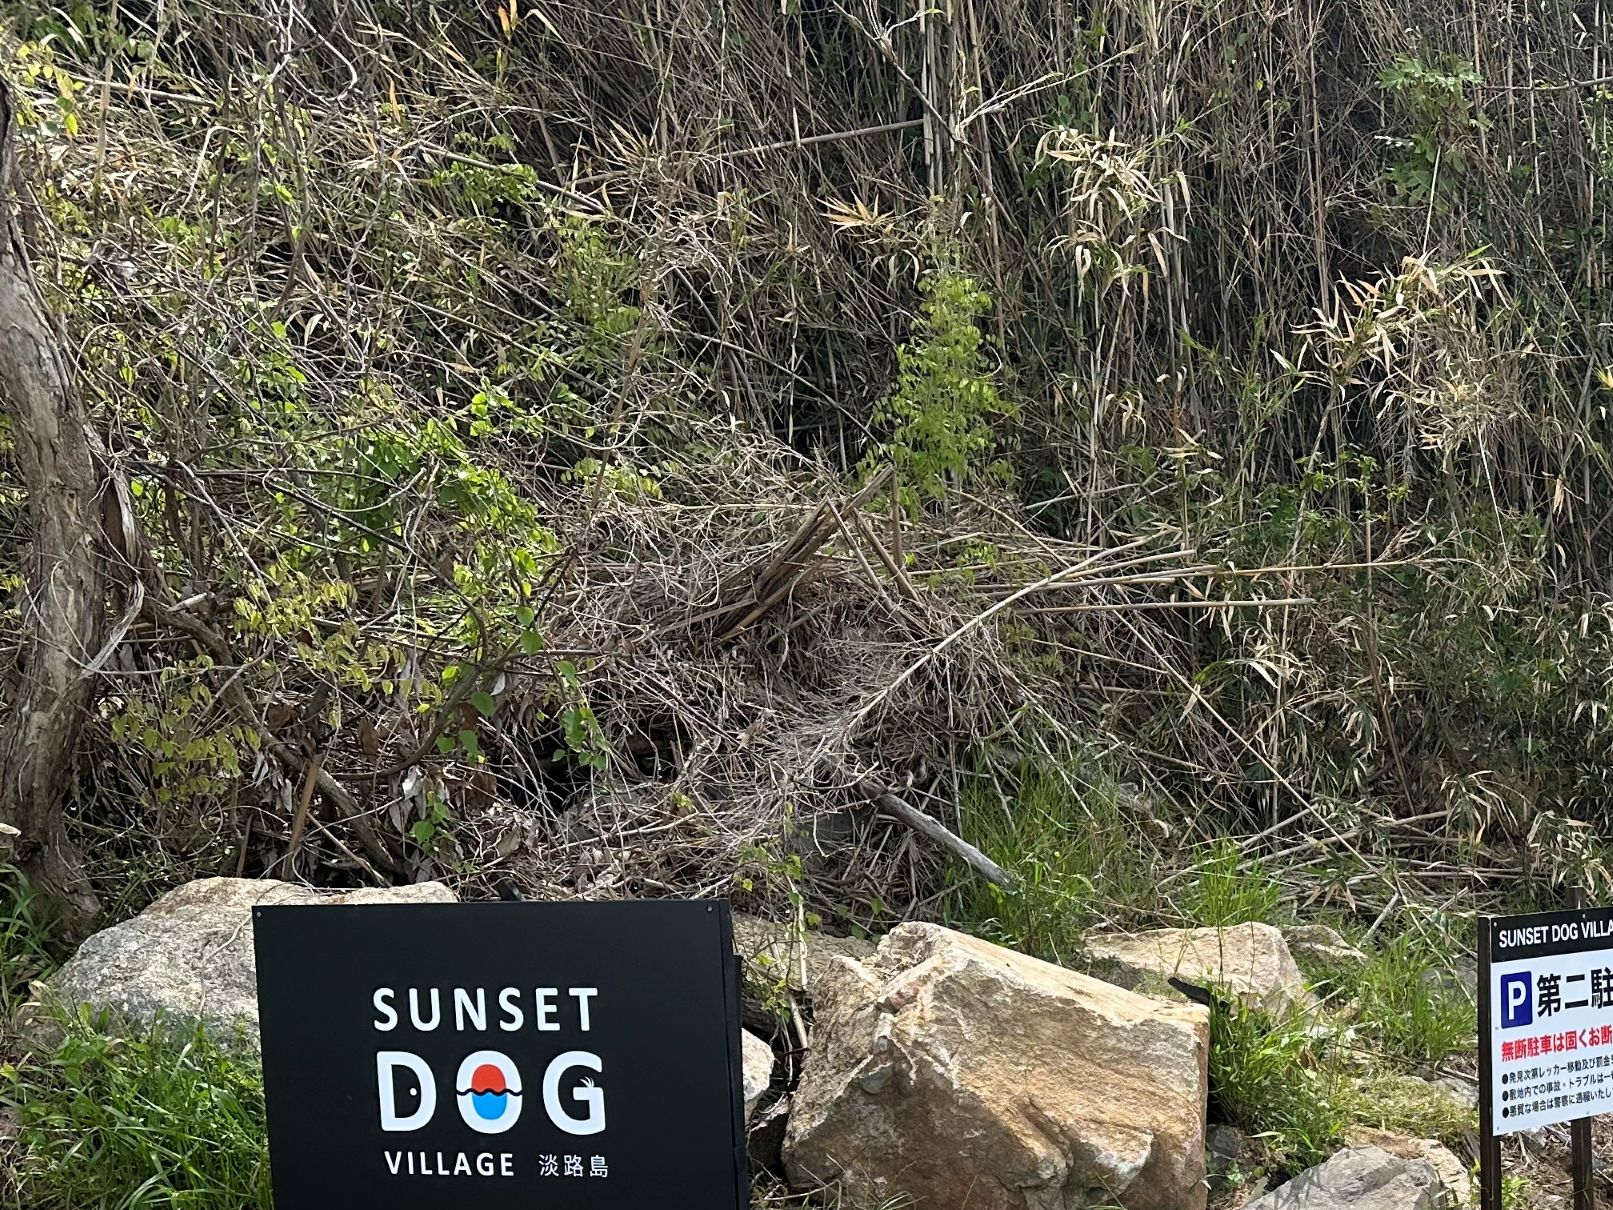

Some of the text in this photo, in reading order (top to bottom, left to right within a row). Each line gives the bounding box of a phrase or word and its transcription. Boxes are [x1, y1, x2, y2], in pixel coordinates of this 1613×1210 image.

[1499, 926, 1549, 948] SUNSET
[1551, 922, 1579, 943] DOG
[373, 987, 598, 1032] SUNSET
[1507, 980, 1527, 1020] P
[376, 1050, 607, 1136] DOG
[384, 1150, 609, 1178] VILLAGE 淡路島
